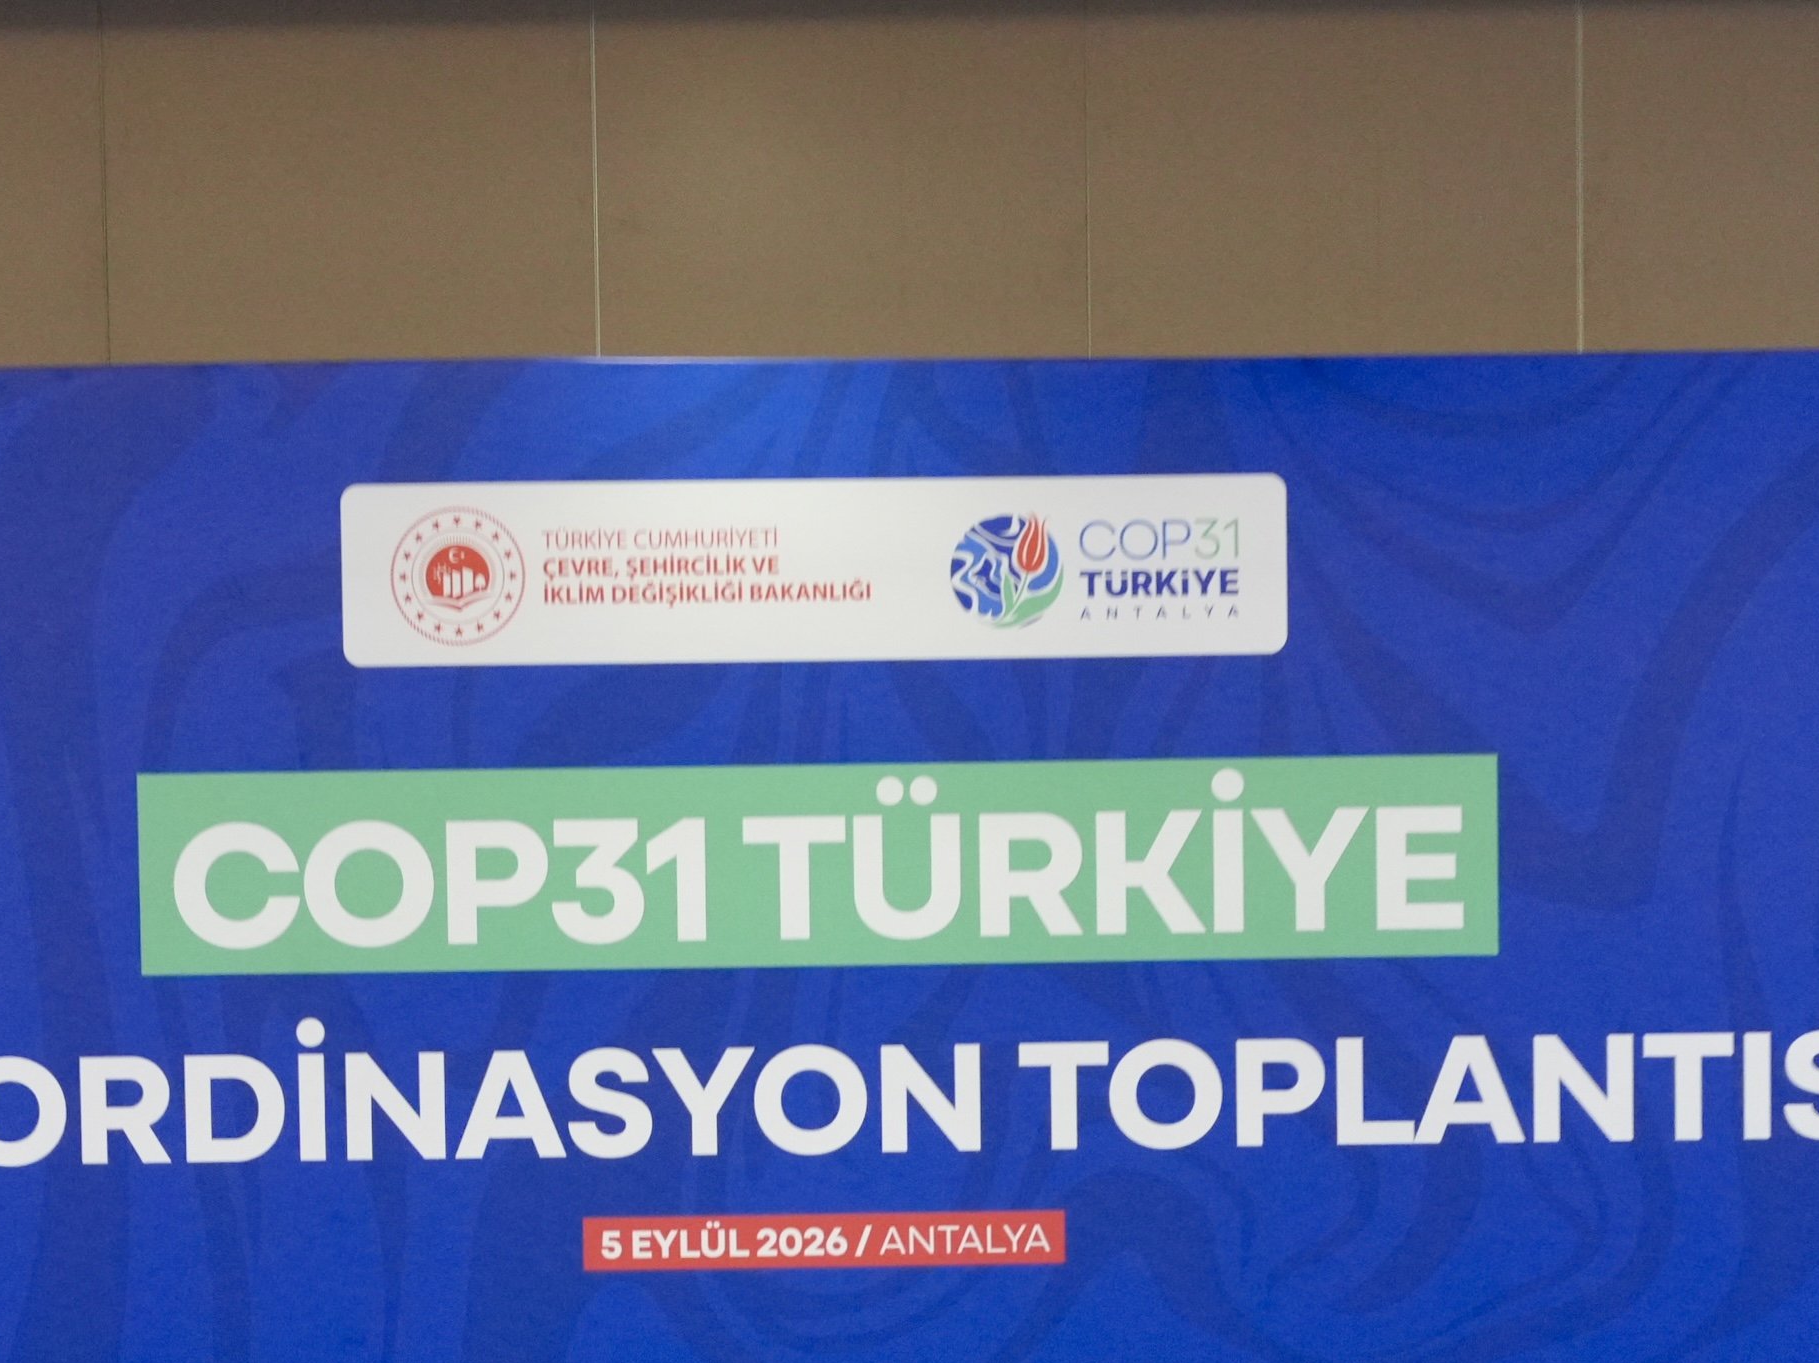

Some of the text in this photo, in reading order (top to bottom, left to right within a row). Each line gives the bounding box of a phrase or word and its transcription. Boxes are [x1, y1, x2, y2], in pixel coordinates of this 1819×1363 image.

[543, 524, 779, 550] TÜRKİYE CUMHURİYETİ
[1079, 519, 1238, 560] COP31
[543, 555, 780, 581] ÇEVRE, ŞEHİRCİLİK VE
[544, 580, 870, 606] İKLİM DEĞİŞİKLİĞİ BAKANLIĞI
[1080, 605, 1238, 620] ANTALYA
[174, 768, 1464, 949] COP31 TÜRKİYE
[601, 1230, 622, 1259] 5
[632, 1221, 750, 1259] EYLÜL
[757, 1227, 847, 1257] 2026
[880, 1224, 1050, 1255] ANTALYA
